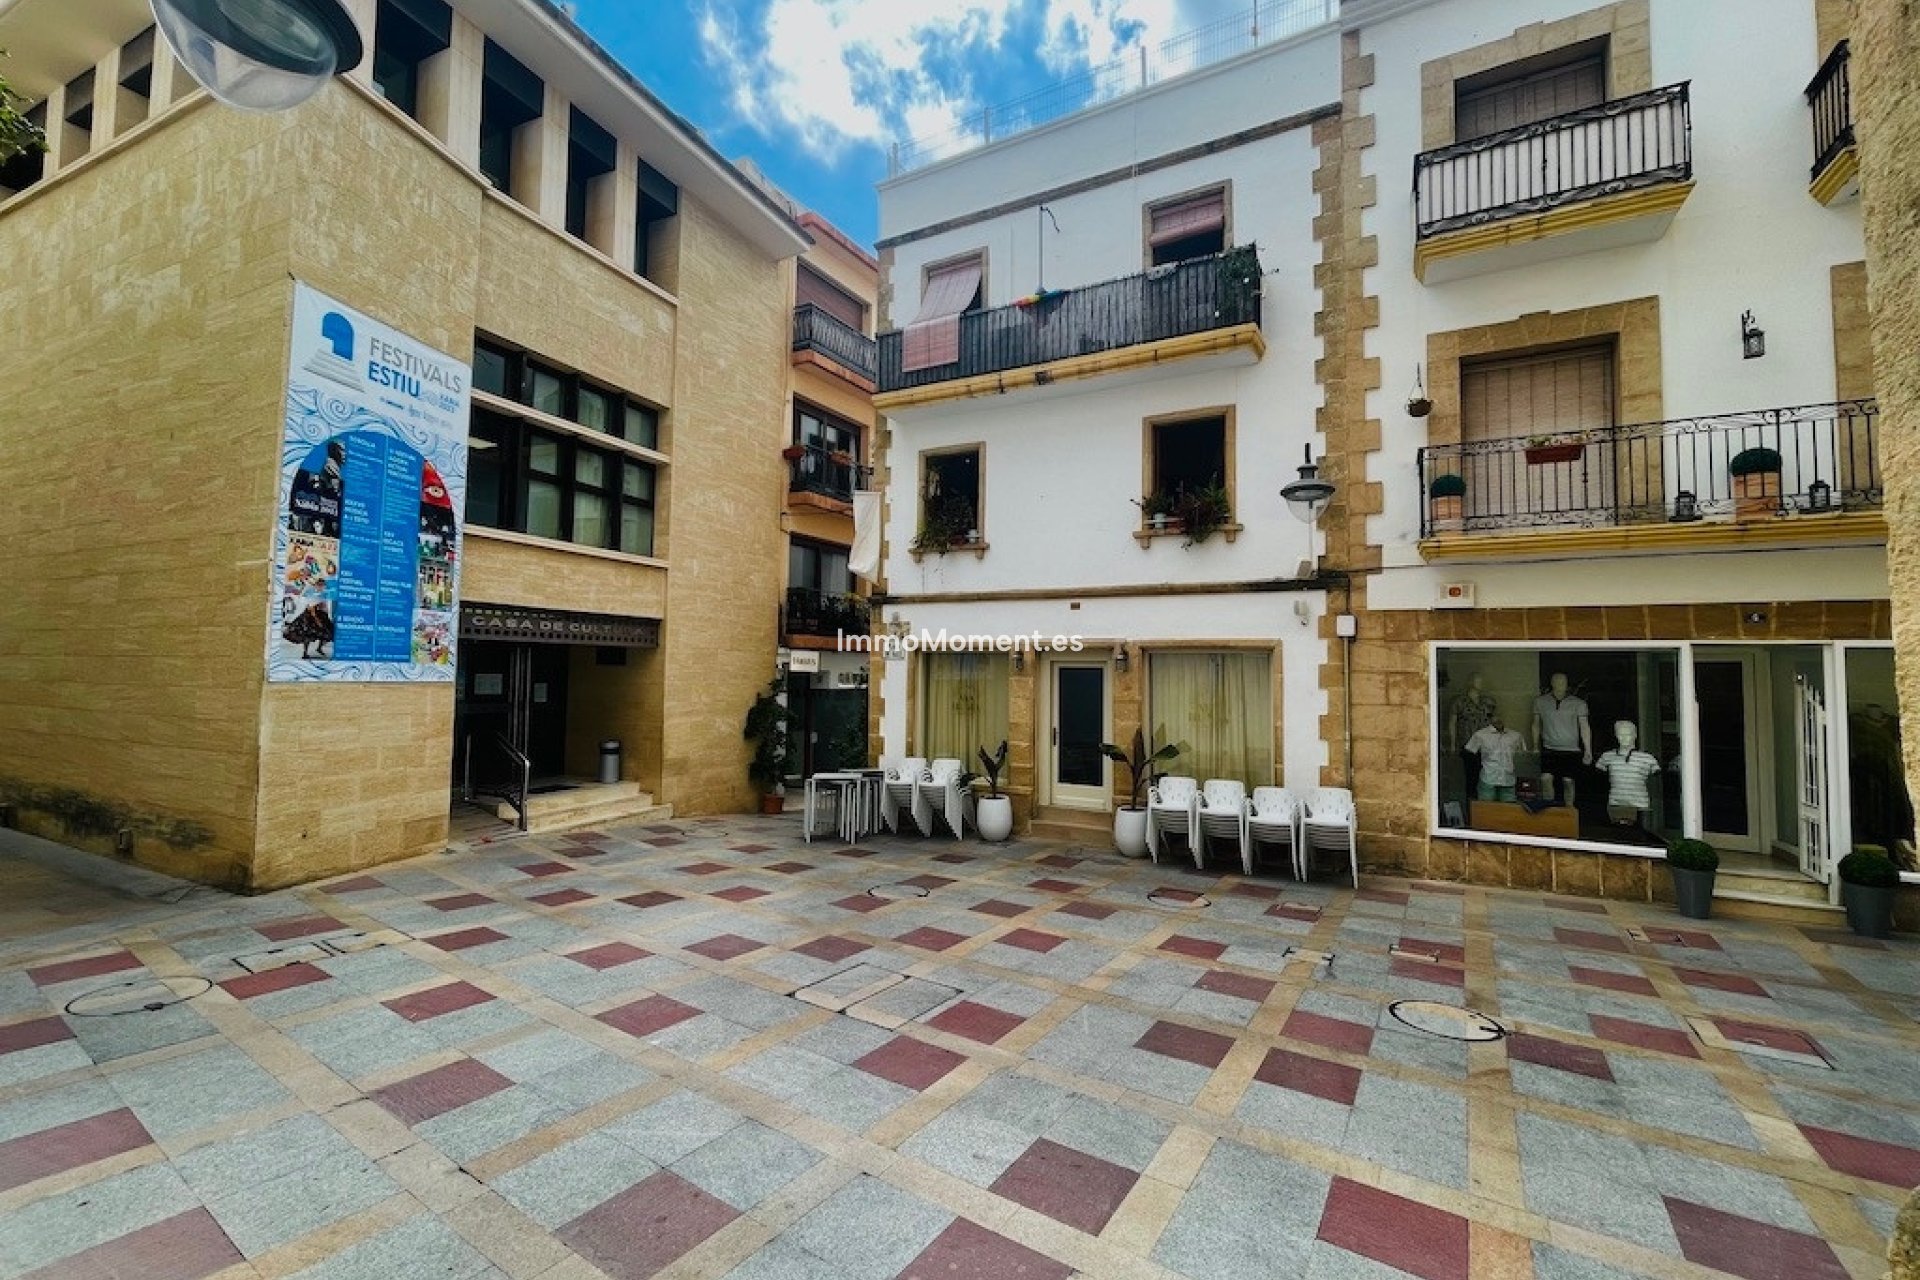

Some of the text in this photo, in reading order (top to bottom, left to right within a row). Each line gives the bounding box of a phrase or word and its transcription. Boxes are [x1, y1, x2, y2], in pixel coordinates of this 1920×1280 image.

[368, 360, 421, 397] ESTIU
[371, 337, 462, 394] FESTIVALS
[472, 616, 534, 630] CASA
[540, 621, 564, 632] DE
